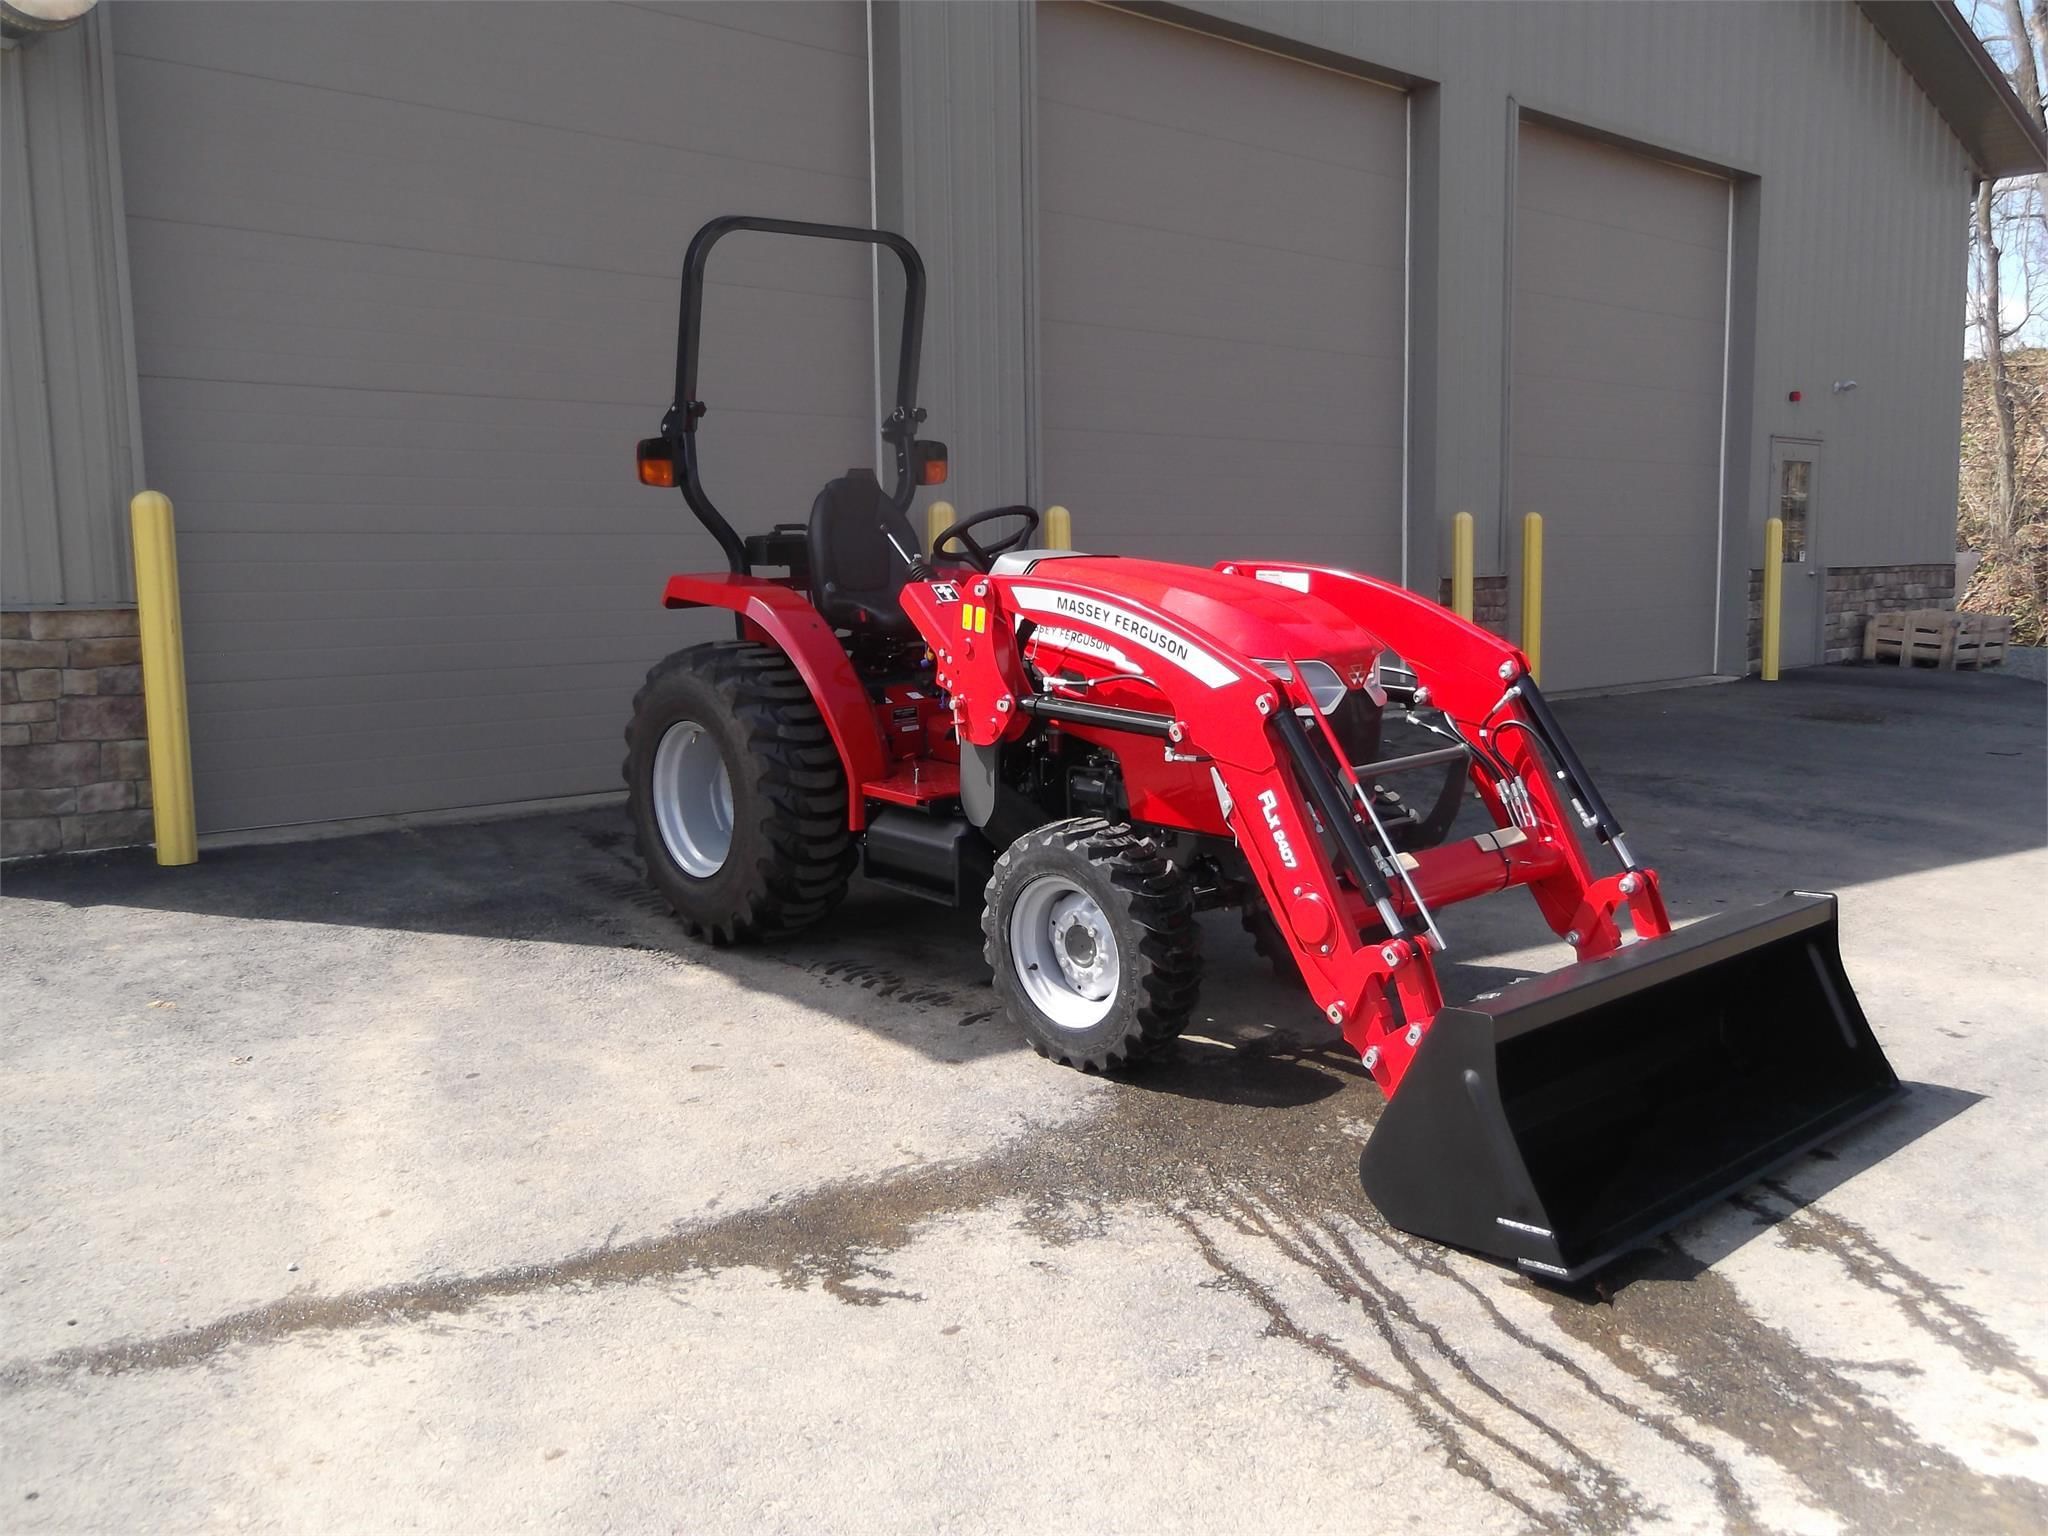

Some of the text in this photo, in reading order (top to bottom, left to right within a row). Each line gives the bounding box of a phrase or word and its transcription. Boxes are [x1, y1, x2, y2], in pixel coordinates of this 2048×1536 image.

[1057, 597, 1188, 660] MASSEY FERGUSON
[1060, 627, 1110, 652] FERGUSON
[1272, 829, 1298, 868] 2407
